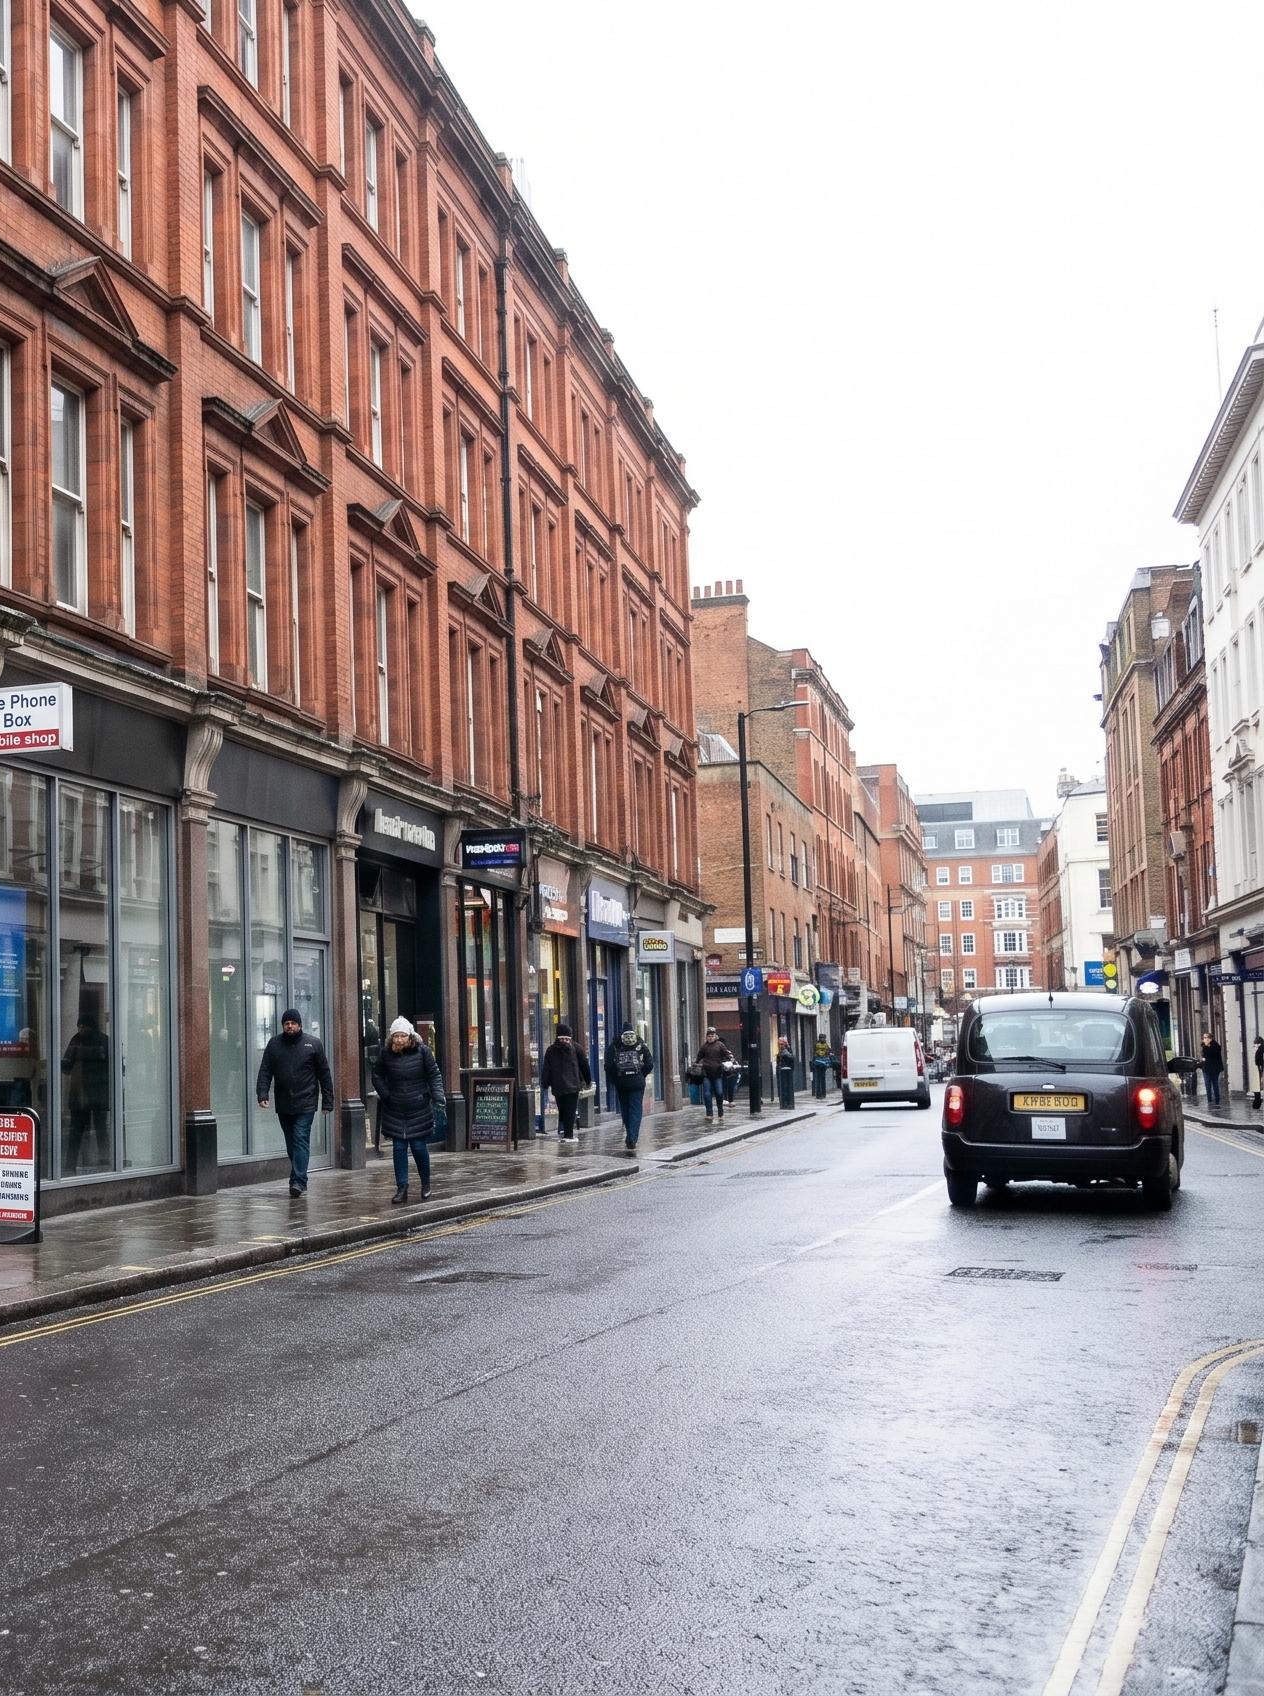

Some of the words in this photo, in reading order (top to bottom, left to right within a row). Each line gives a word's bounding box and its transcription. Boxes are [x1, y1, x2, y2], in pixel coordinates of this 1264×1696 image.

[10, 694, 56, 709] Phone
[4, 713, 32, 728] Box
[24, 733, 56, 746] shop
